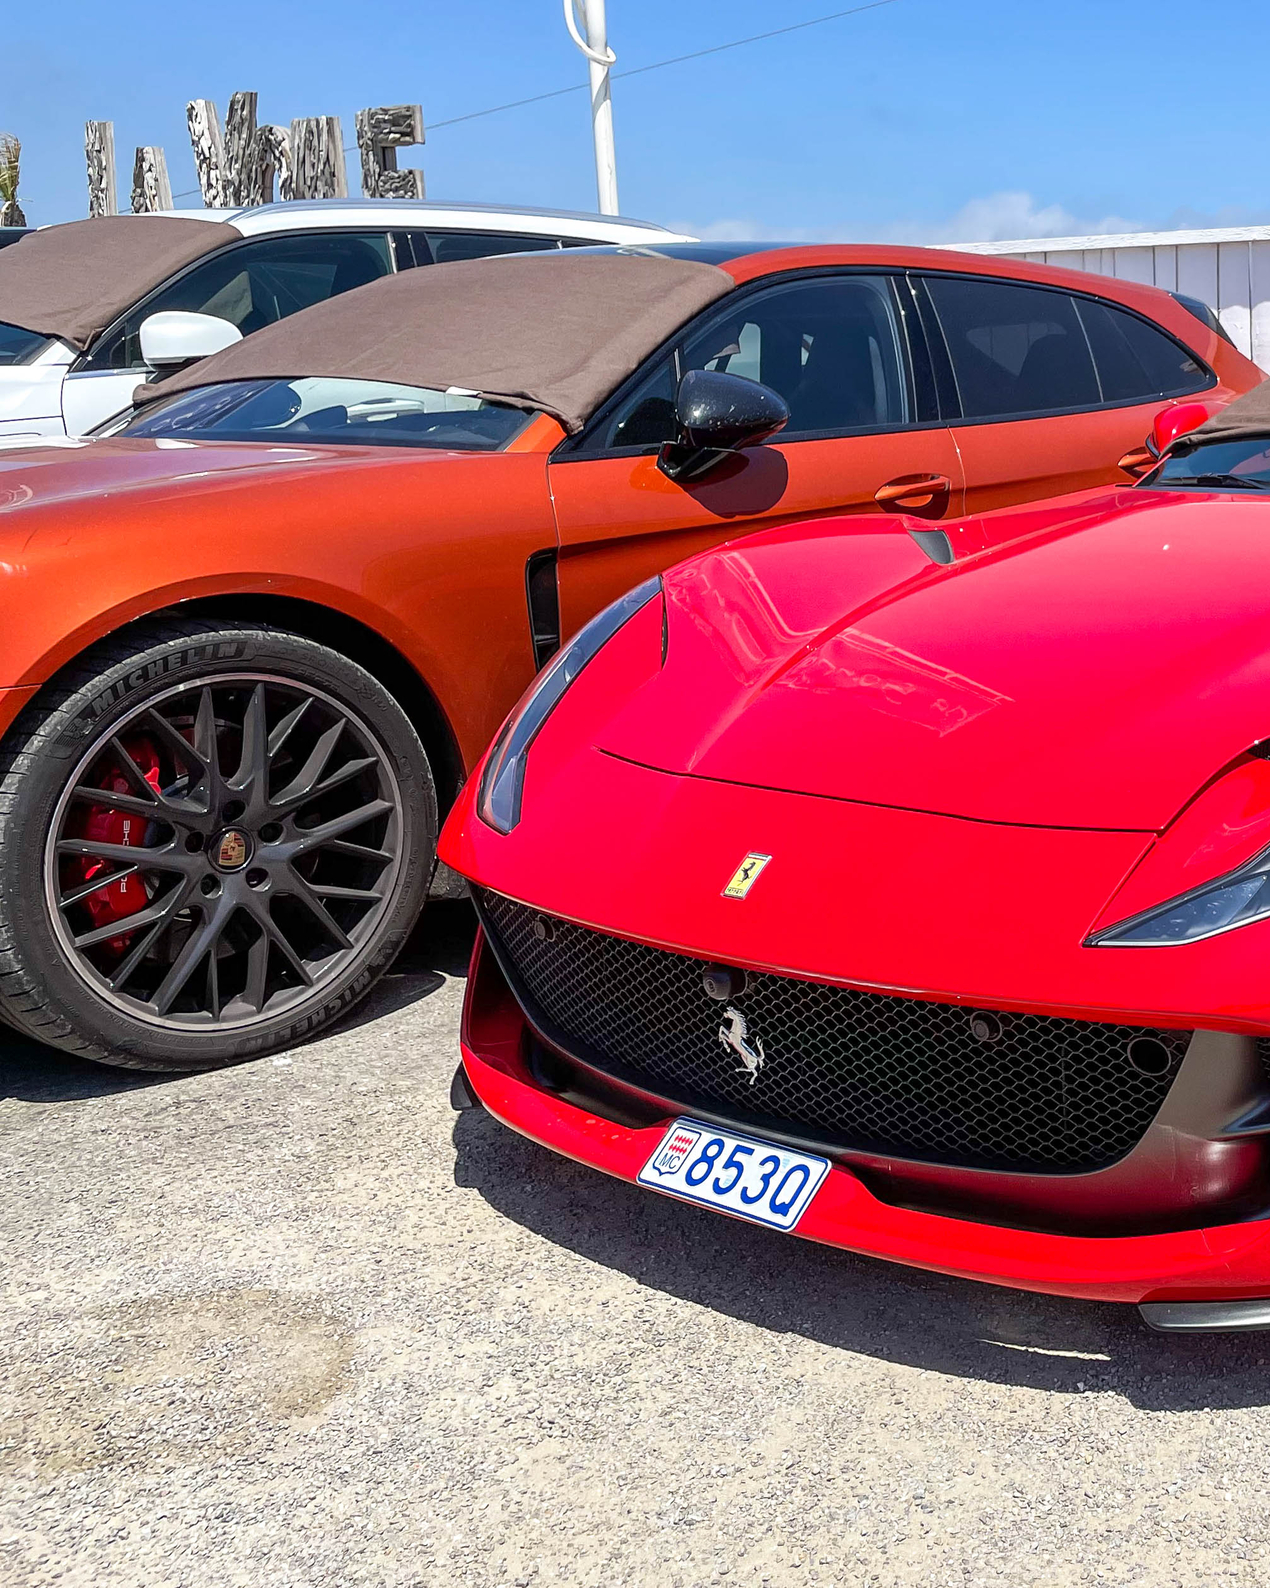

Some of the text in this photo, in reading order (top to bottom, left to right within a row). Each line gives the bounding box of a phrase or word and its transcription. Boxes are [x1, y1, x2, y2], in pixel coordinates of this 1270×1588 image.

[91, 642, 239, 715] MICHELIN
[248, 970, 372, 1051] MICHELIN
[659, 1138, 811, 1218] MC 853Q
